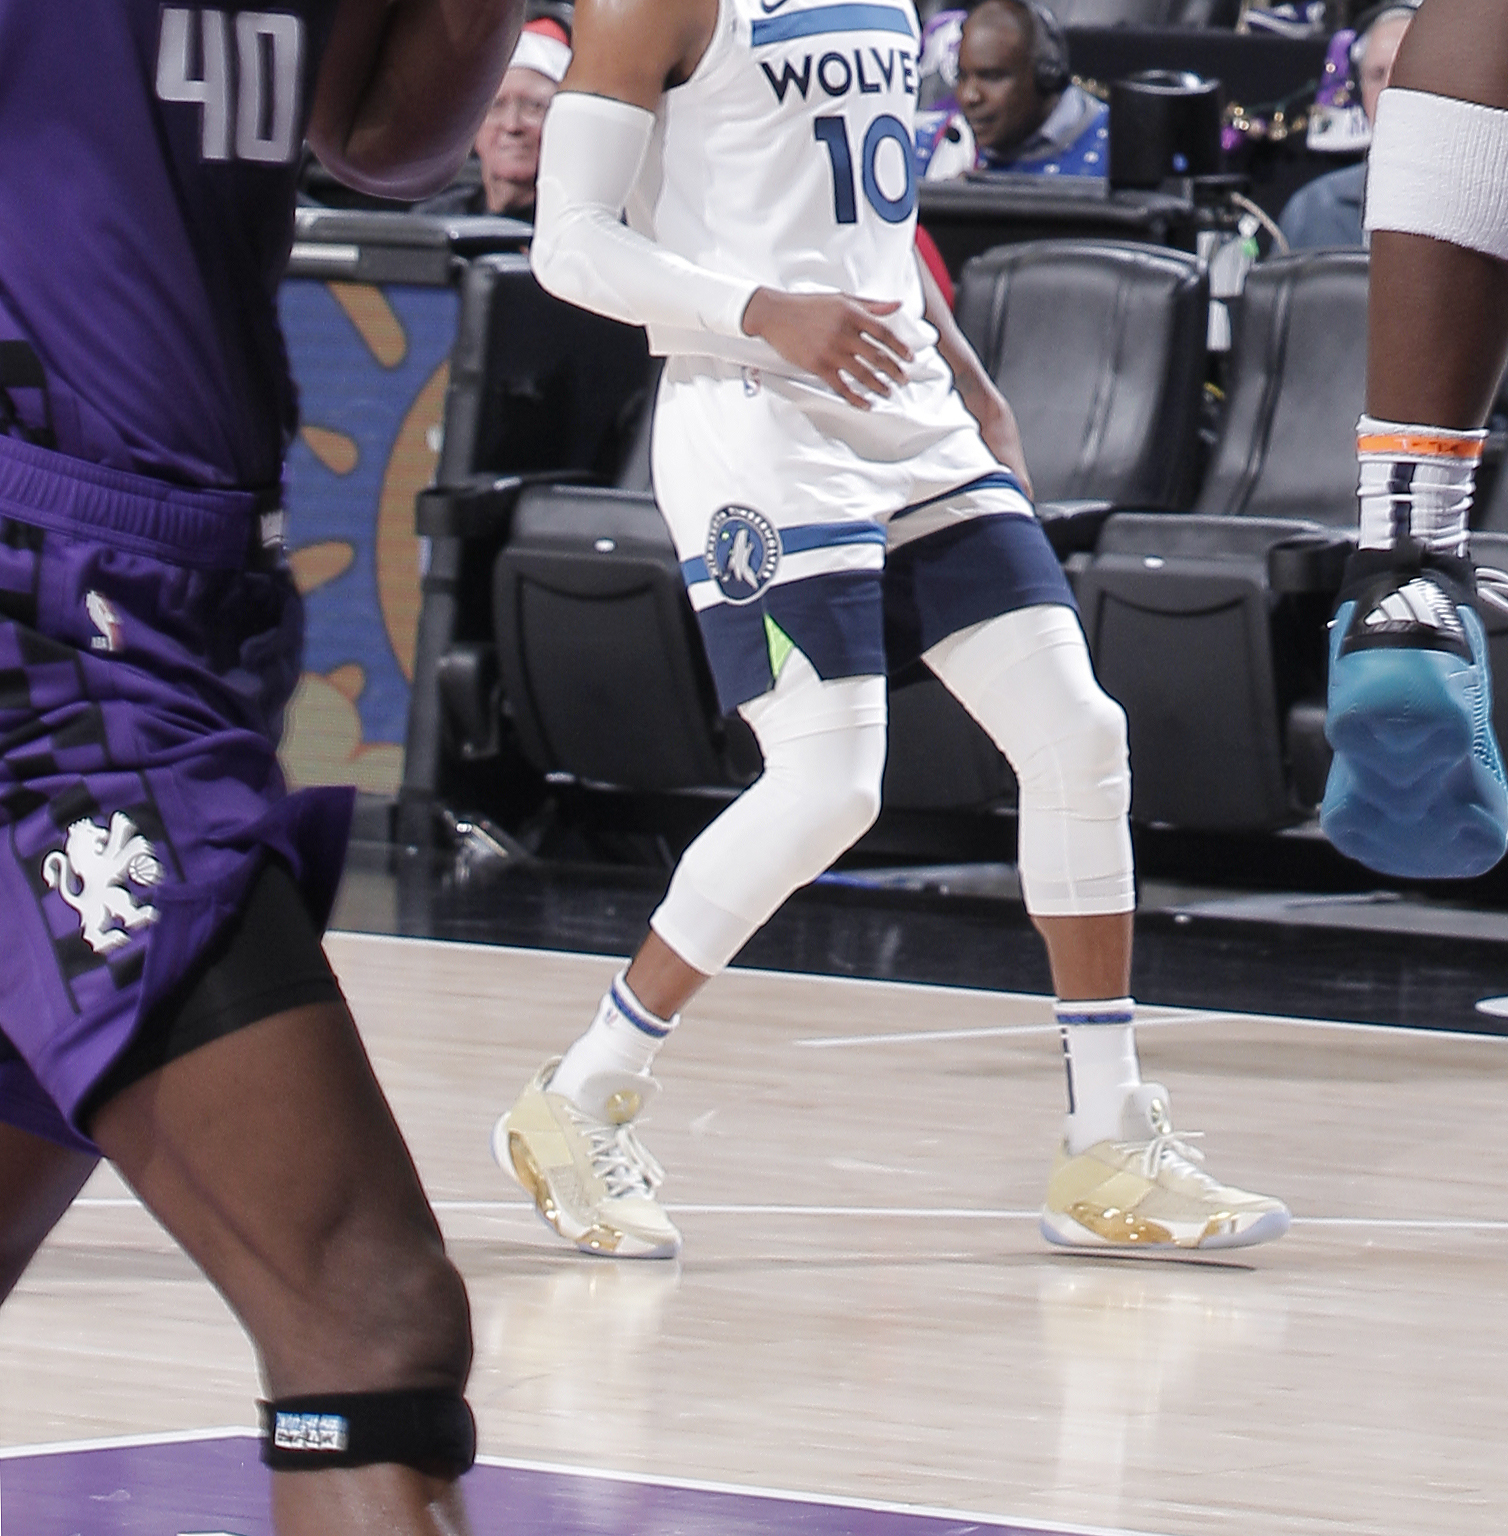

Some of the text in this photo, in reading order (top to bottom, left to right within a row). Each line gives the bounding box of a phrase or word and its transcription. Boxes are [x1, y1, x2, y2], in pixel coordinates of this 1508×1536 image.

[155, 6, 301, 164] 40
[760, 46, 921, 105] WOLVE
[813, 113, 917, 225] 10
